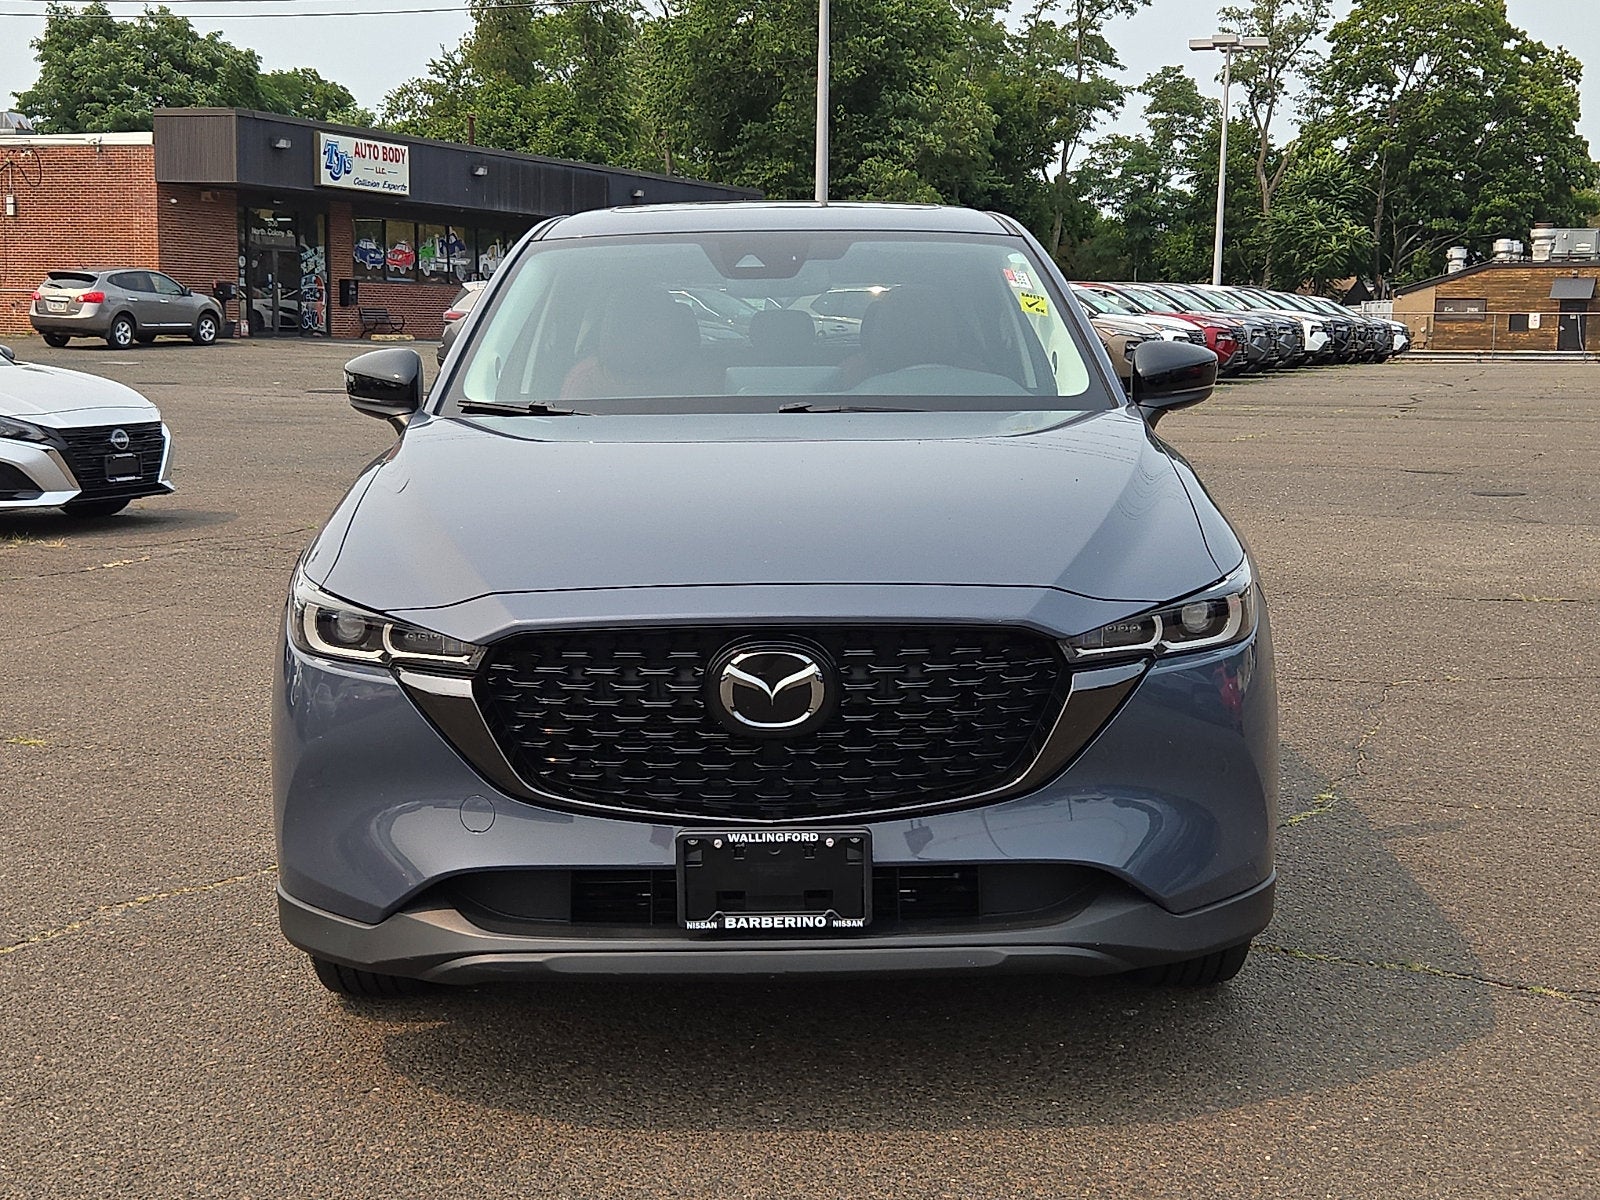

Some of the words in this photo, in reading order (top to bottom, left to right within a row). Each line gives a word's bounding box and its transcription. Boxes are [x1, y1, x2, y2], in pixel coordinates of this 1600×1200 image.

[354, 142, 379, 160] AUTO
[382, 146, 406, 164] BODY
[353, 177, 380, 188] Collision
[382, 180, 407, 192] Experts
[727, 832, 819, 843] WALLINGFORD
[686, 921, 718, 930] NISSAN
[724, 916, 827, 929] BARBERINO
[832, 919, 864, 928] NISSAN
